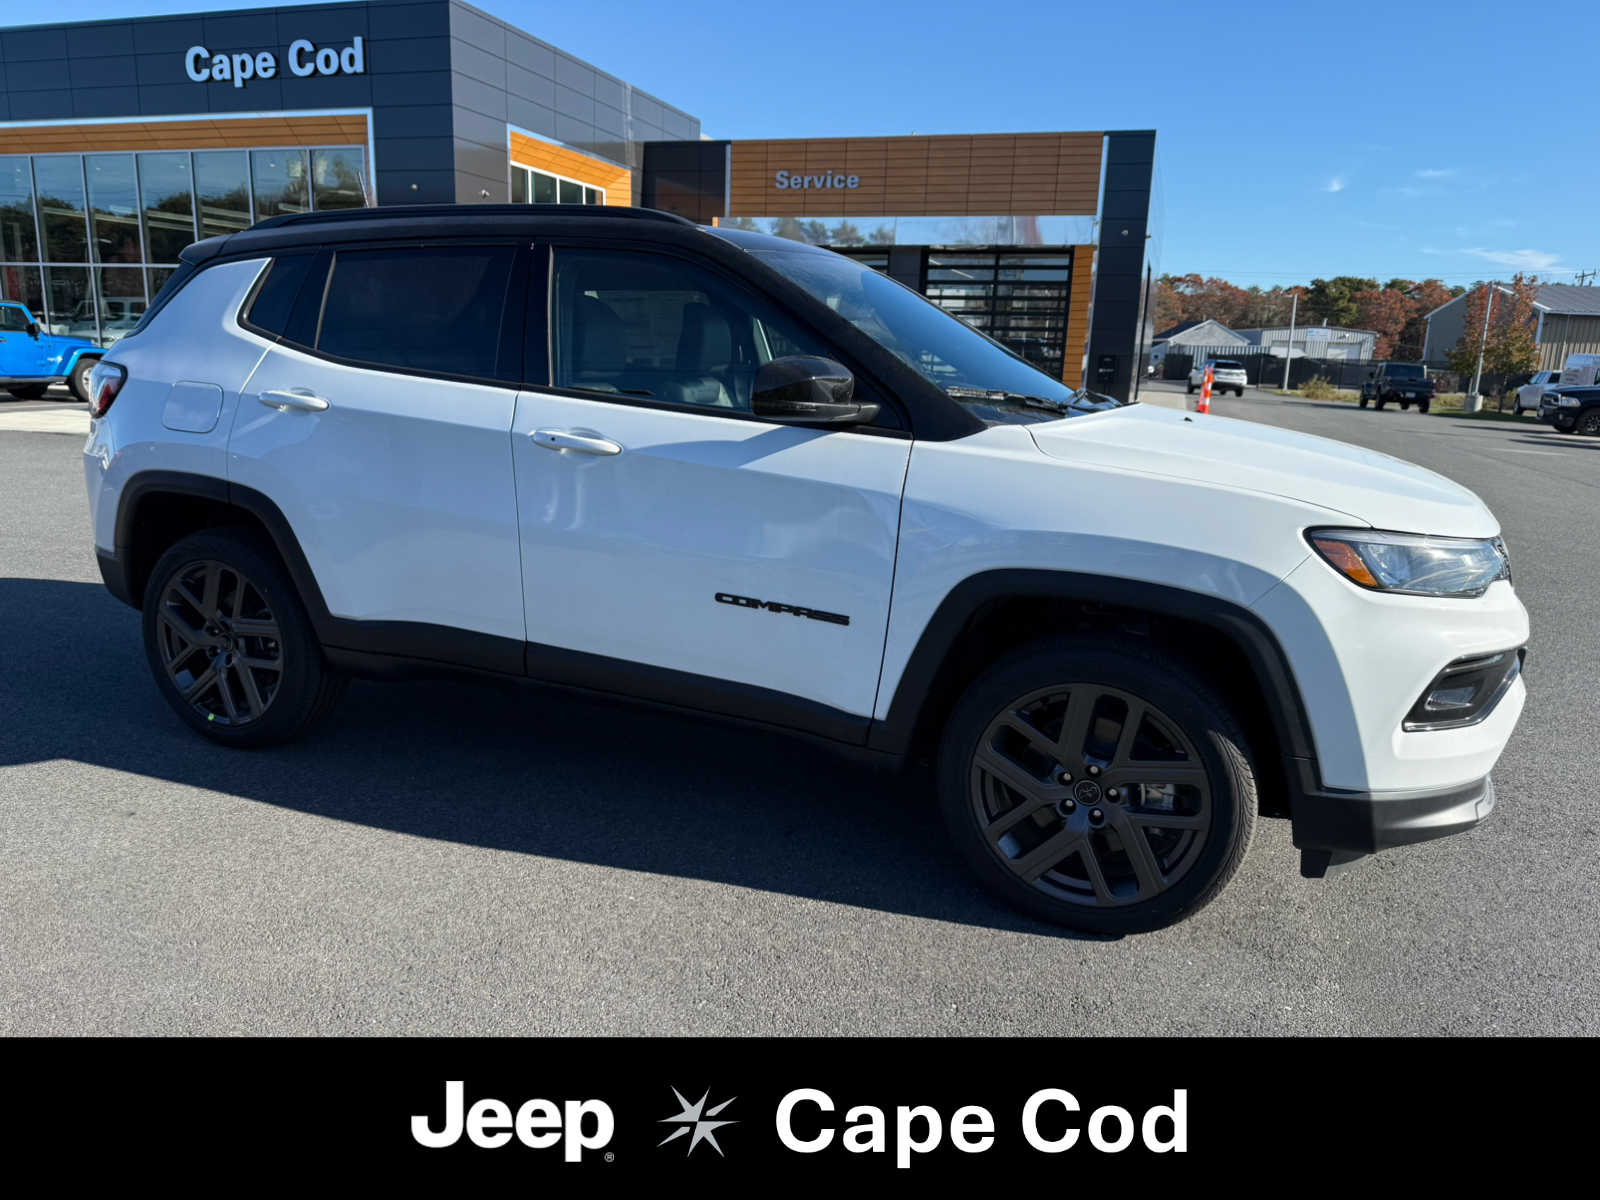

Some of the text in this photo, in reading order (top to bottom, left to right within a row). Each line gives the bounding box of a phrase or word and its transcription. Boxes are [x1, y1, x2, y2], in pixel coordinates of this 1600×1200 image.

[185, 36, 365, 88] Cape Cod
[775, 170, 860, 190] Service
